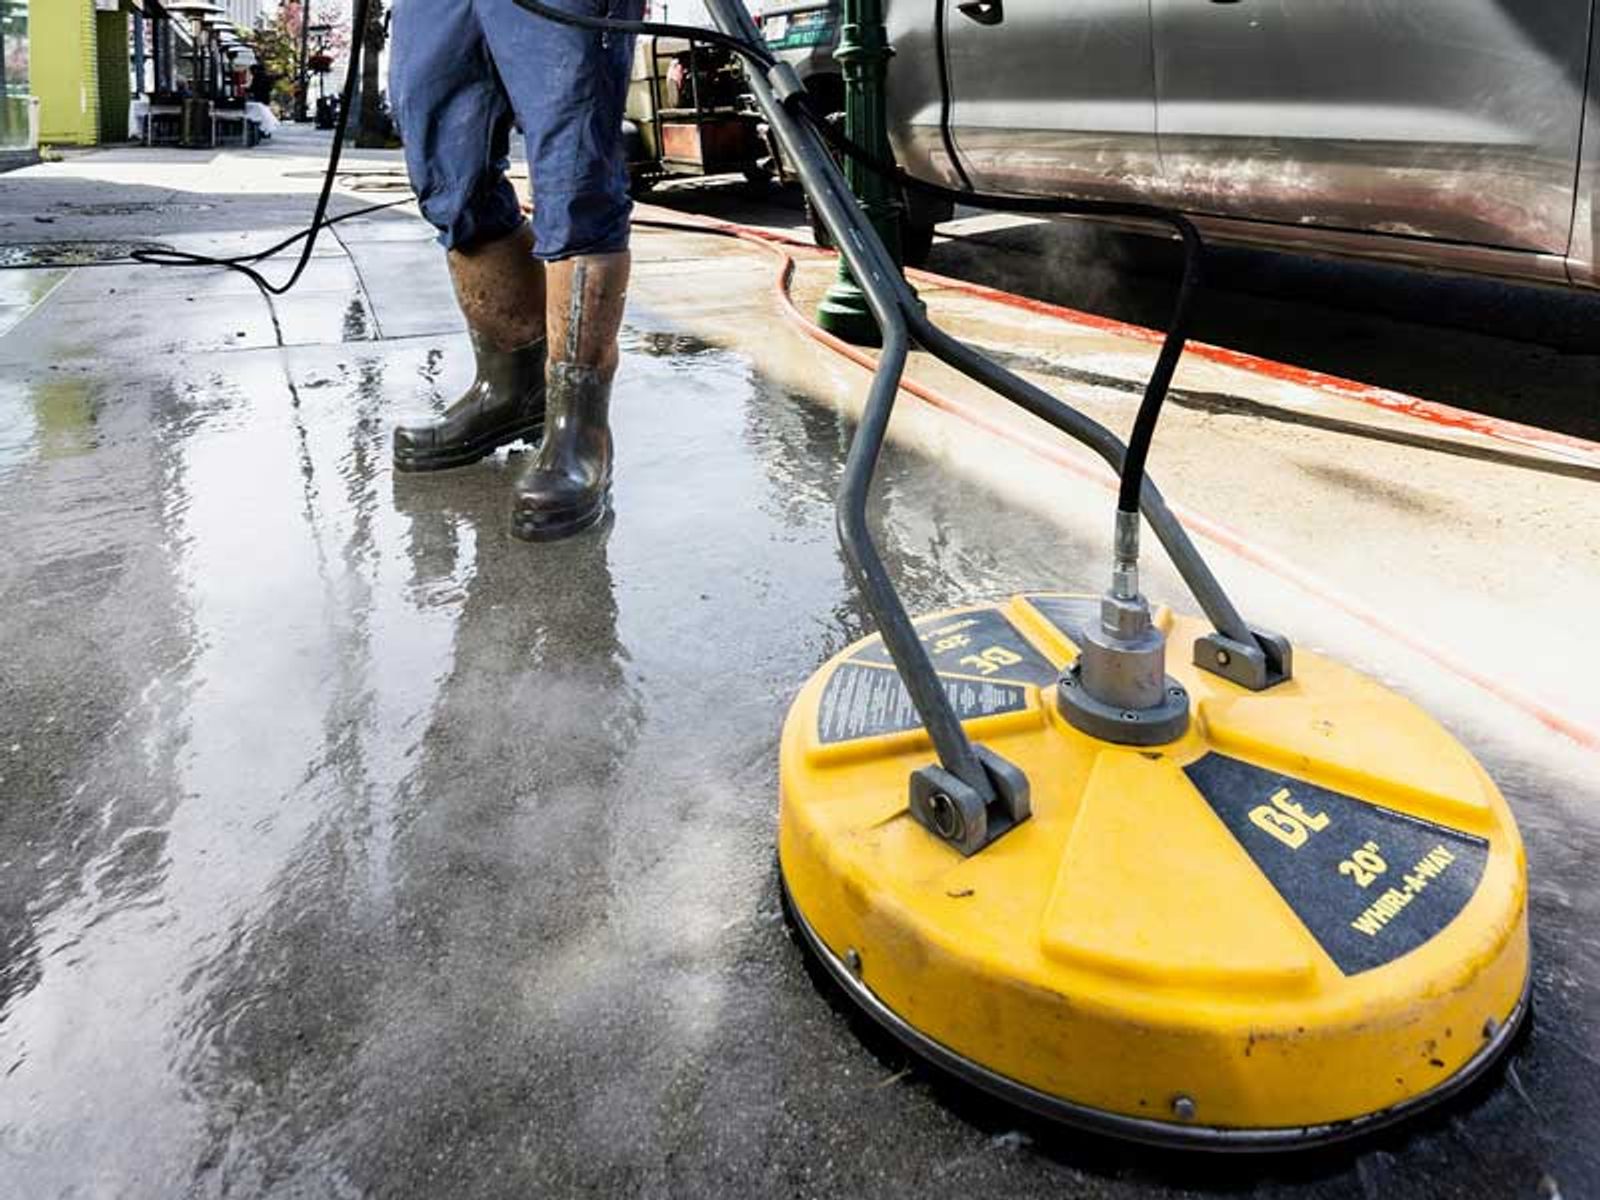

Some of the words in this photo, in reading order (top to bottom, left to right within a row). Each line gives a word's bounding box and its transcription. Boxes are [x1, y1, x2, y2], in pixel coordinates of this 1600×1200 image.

[1248, 789, 1331, 849] BE
[1339, 841, 1388, 888] 20"
[1352, 845, 1455, 936] WHIRL-A-WAY
